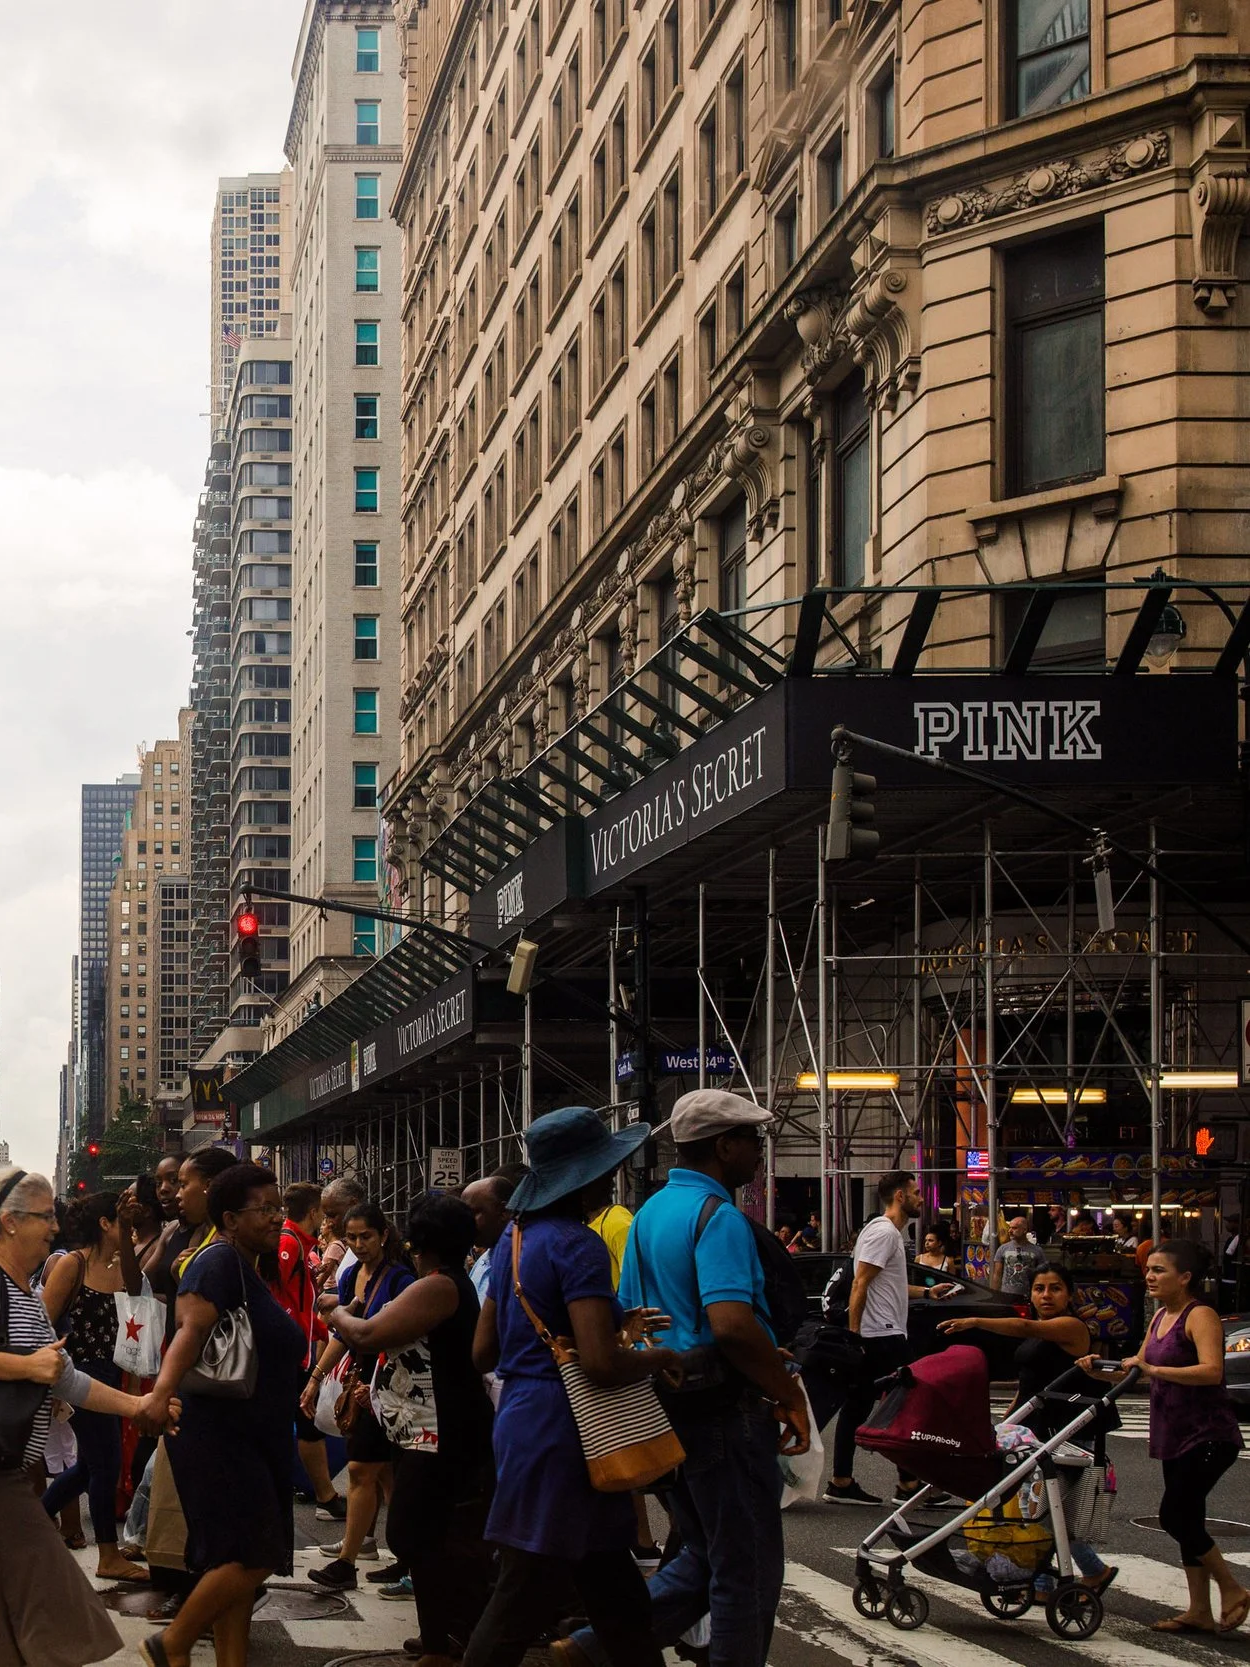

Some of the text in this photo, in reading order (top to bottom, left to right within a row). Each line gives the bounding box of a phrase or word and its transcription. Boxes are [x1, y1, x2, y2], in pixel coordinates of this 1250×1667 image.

[914, 700, 1102, 761] PINK
[590, 726, 766, 876] VICTORIA'S SECRET
[497, 871, 524, 930] PINK
[397, 989, 466, 1057] VICTORIA'S SECRET
[665, 1055, 698, 1069] West
[434, 1171, 459, 1186] 25
